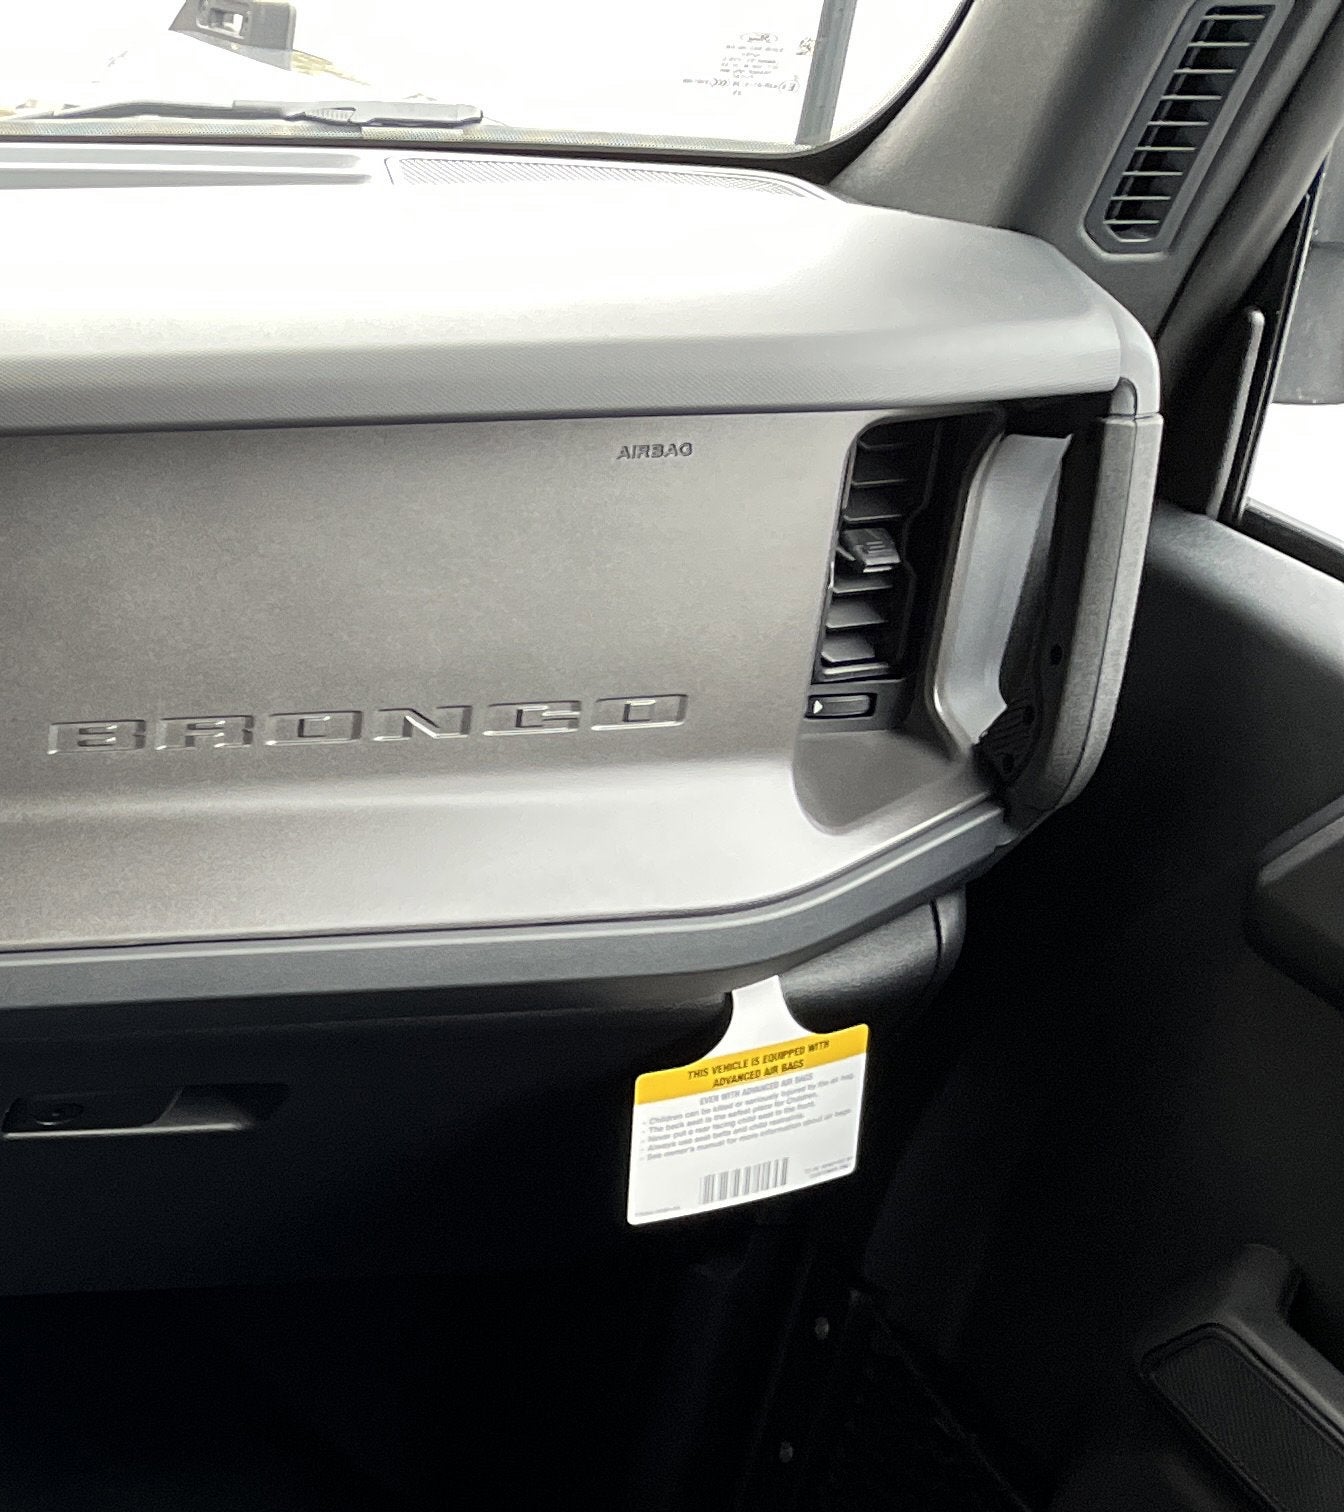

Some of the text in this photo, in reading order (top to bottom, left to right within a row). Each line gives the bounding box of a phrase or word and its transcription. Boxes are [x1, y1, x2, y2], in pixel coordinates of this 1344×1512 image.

[616, 442, 693, 460] AIRBAG
[46, 693, 690, 755] BRONCO
[688, 1040, 830, 1080] THIS VEHICLE IS EQUIPPED WITH
[712, 1059, 804, 1088] ADVANCED AIR BAGS
